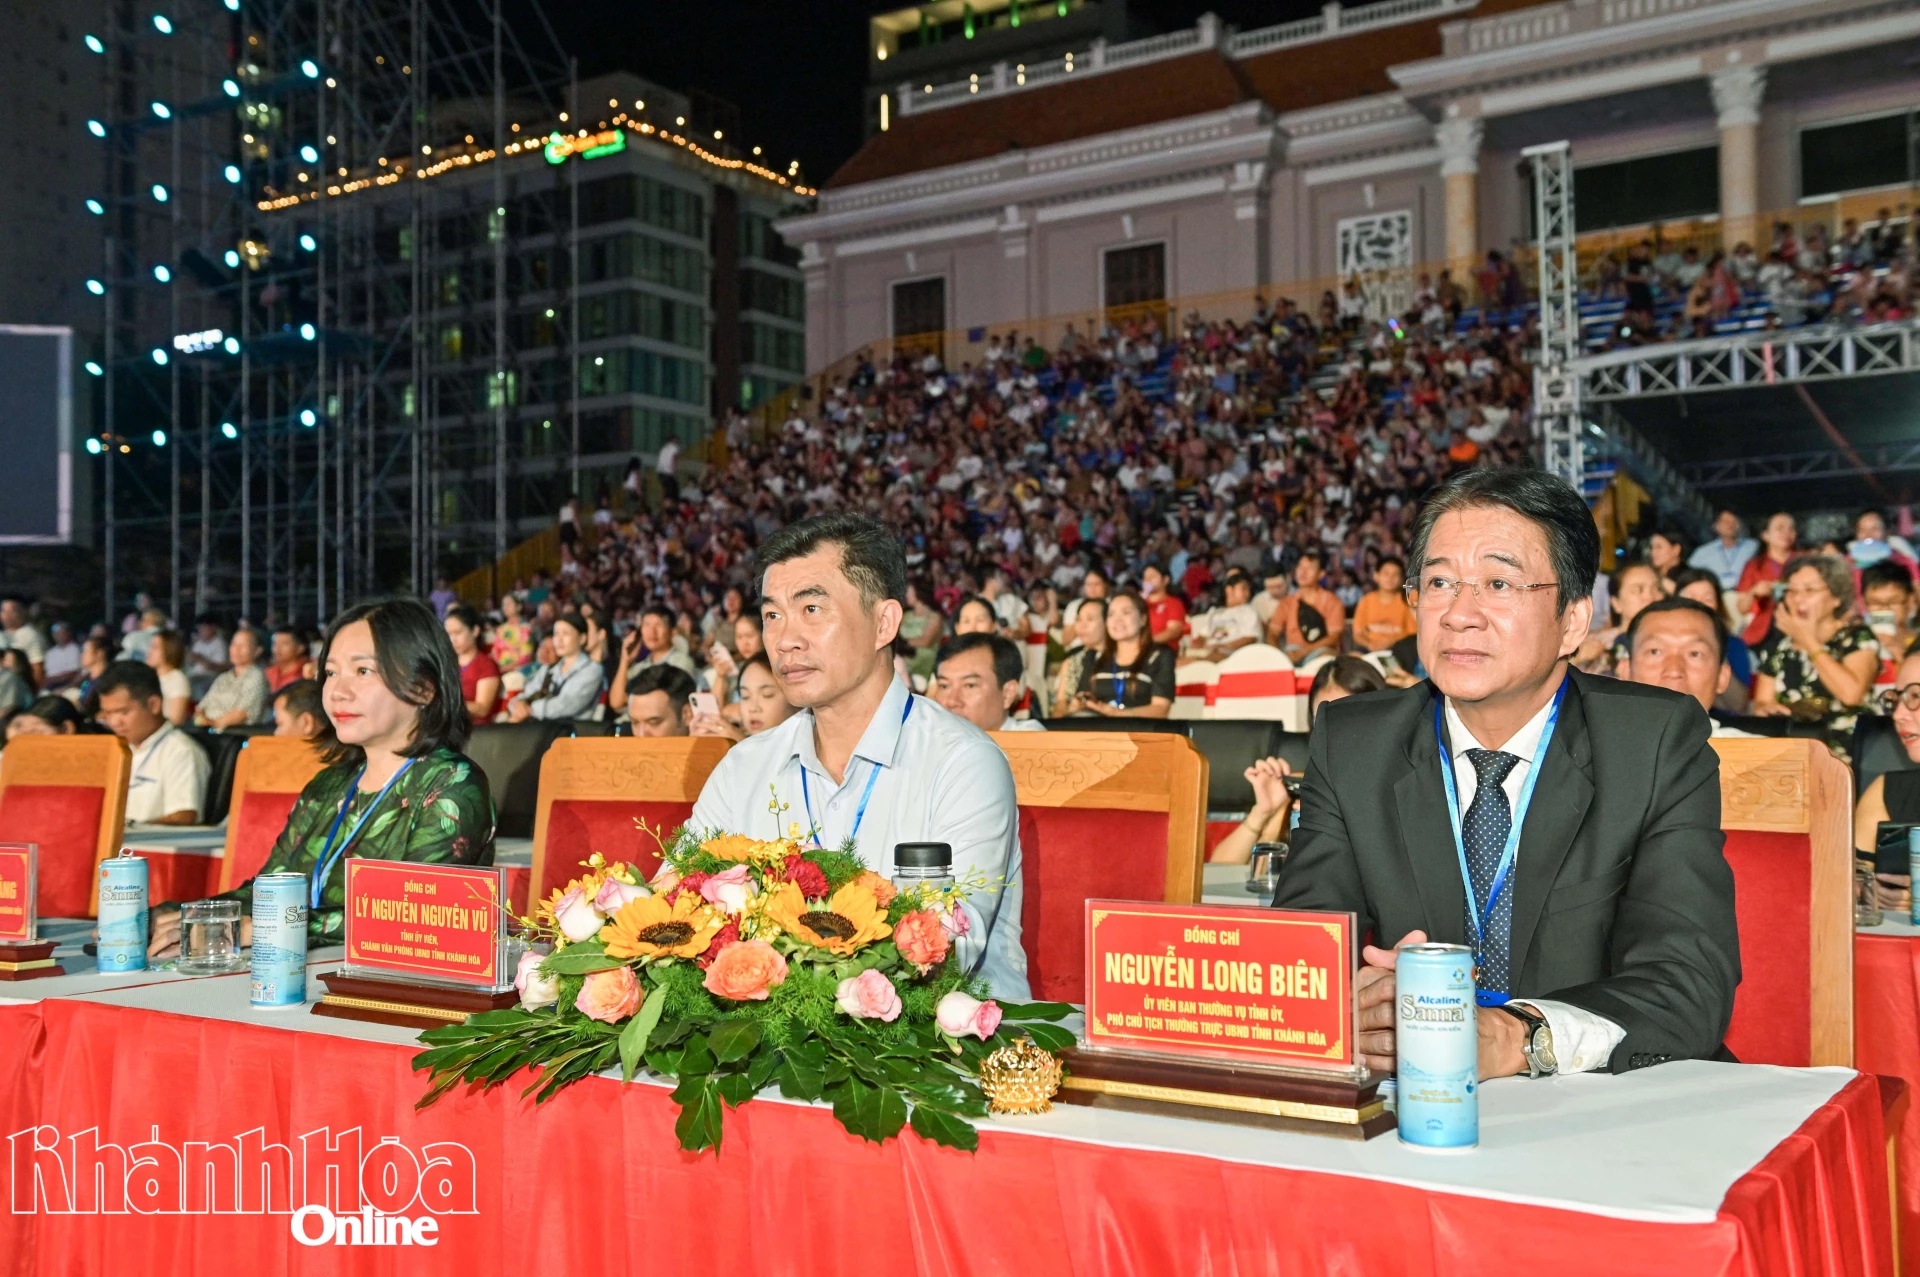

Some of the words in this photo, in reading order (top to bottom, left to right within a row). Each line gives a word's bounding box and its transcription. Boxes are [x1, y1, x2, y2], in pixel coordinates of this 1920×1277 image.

[102, 886, 141, 901] Sanna
[425, 882, 436, 895] CHÍ
[356, 893, 369, 918] LÝ
[372, 894, 418, 924] NGUYỄN
[421, 903, 469, 930] NGUYÊN
[472, 906, 488, 932] VŨ
[1184, 924, 1216, 944] ĐỒNG
[1219, 929, 1240, 946] CHÍ
[446, 952, 467, 964] KHÁNH
[1105, 945, 1194, 989] NGUYỄN
[1201, 959, 1263, 995] LONG
[1270, 959, 1327, 1001] BIÊN
[1143, 994, 1155, 1011] ỦY
[1156, 997, 1176, 1013] VIÊN
[1178, 1000, 1196, 1014] BAN
[1198, 1001, 1233, 1017] THƯỜNG
[1234, 1005, 1246, 1021] VỤ
[1248, 1003, 1269, 1021] TỈNH
[1401, 994, 1465, 1022] Sanna
[1417, 996, 1462, 1005] Alcaline
[1107, 1012, 1124, 1027] PHÓ
[1125, 1012, 1142, 1028] CHỦ
[1144, 1016, 1163, 1032] TỊCH
[1165, 1017, 1198, 1034] THƯỜNG
[1200, 1021, 1223, 1038] TRỰC
[1225, 1024, 1249, 1038] UBND
[1251, 1023, 1272, 1041] TỈNH
[1274, 1027, 1305, 1044] KHÁNH
[1307, 1029, 1327, 1046] HÒA
